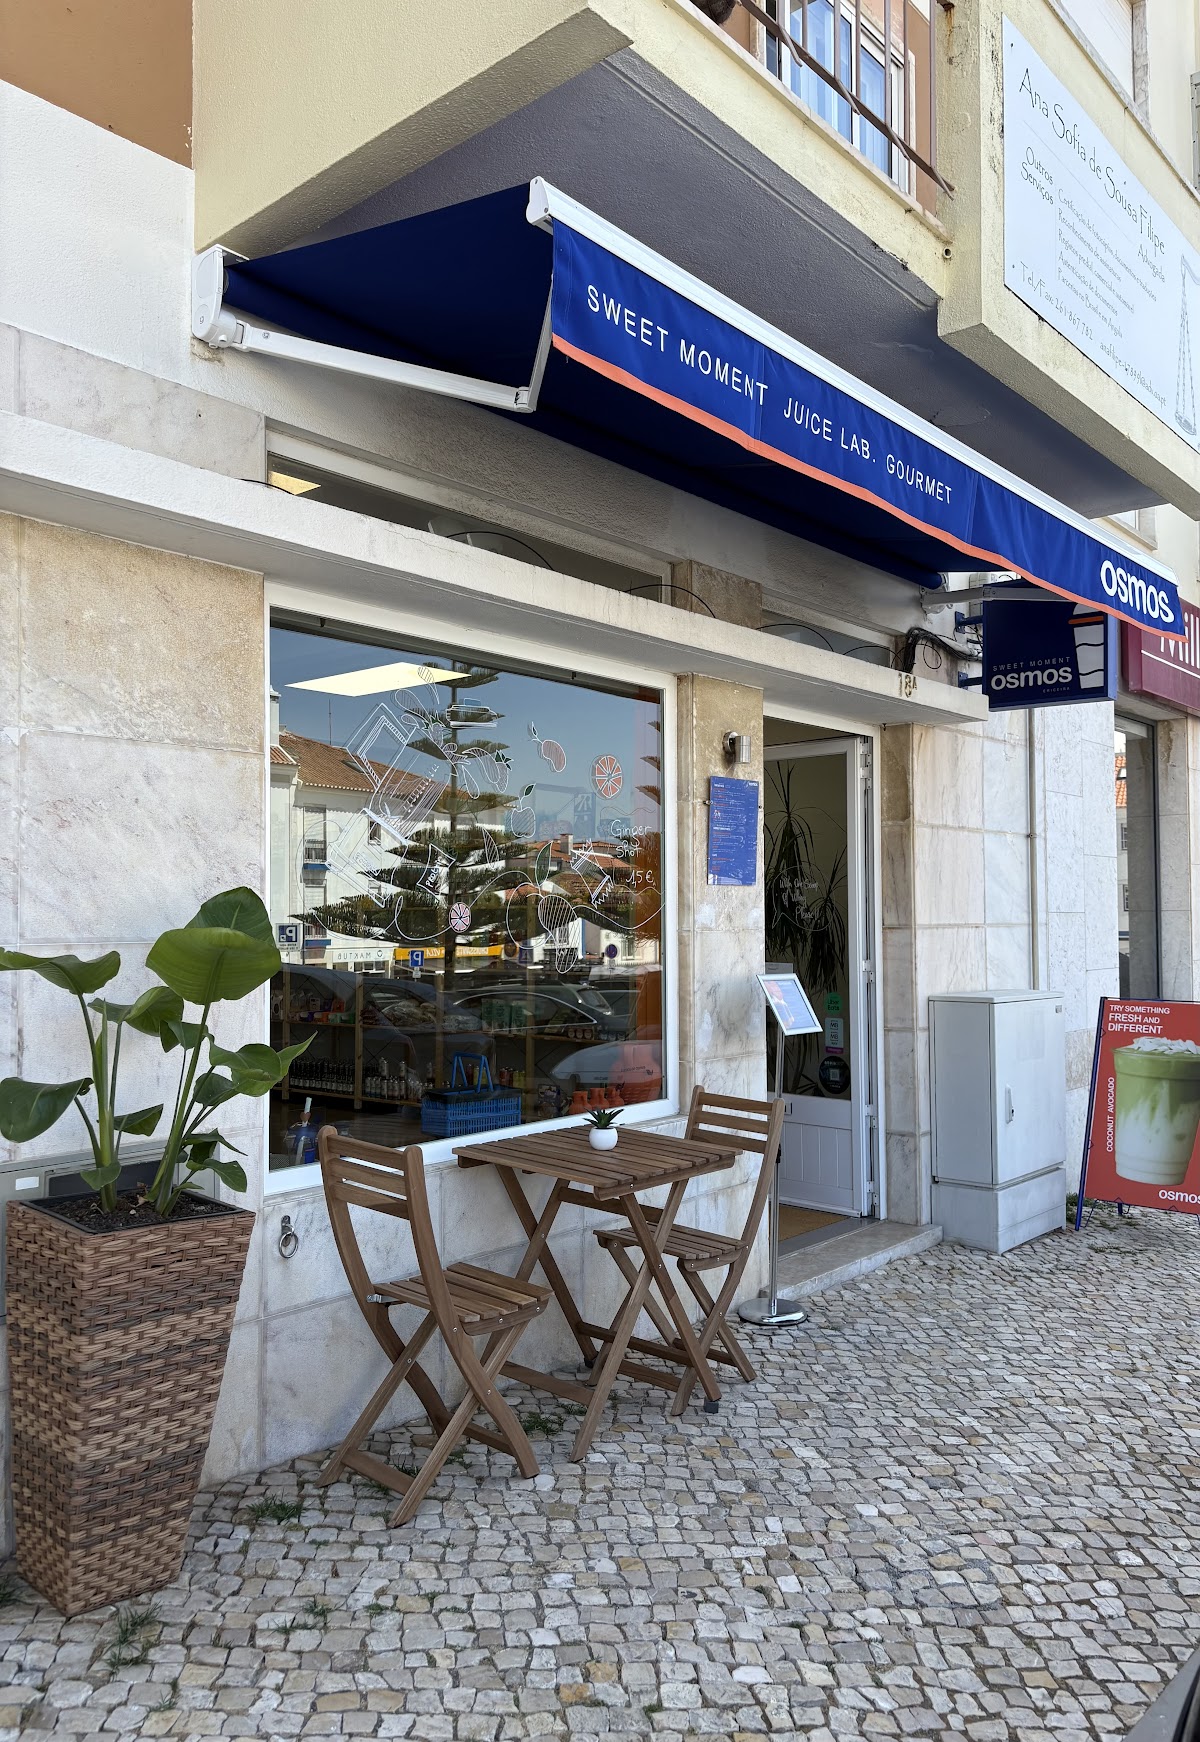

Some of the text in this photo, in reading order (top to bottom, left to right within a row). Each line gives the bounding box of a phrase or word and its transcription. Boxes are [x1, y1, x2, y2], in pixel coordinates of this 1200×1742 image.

[1019, 68, 1164, 257] Ana Sofia de Sousa Filipe
[1026, 147, 1054, 185] Outros
[1020, 162, 1054, 205] Serviços
[1138, 244, 1165, 283] Advogada
[587, 285, 952, 504] SWEET MOMENT JUICE LAB. GOURMET
[1100, 560, 1174, 623] osmos
[990, 666, 1072, 690] osmos
[992, 656, 1070, 672] SWEET MOMENT
[611, 820, 652, 847] Ginger
[616, 840, 642, 858] Shot
[1108, 1012, 1160, 1024] FRESH AND
[1110, 1004, 1170, 1014] TRY SOMETHING
[1108, 1023, 1163, 1034] DIFFERENT
[1106, 1077, 1115, 1152] COCONUT AVOCADO
